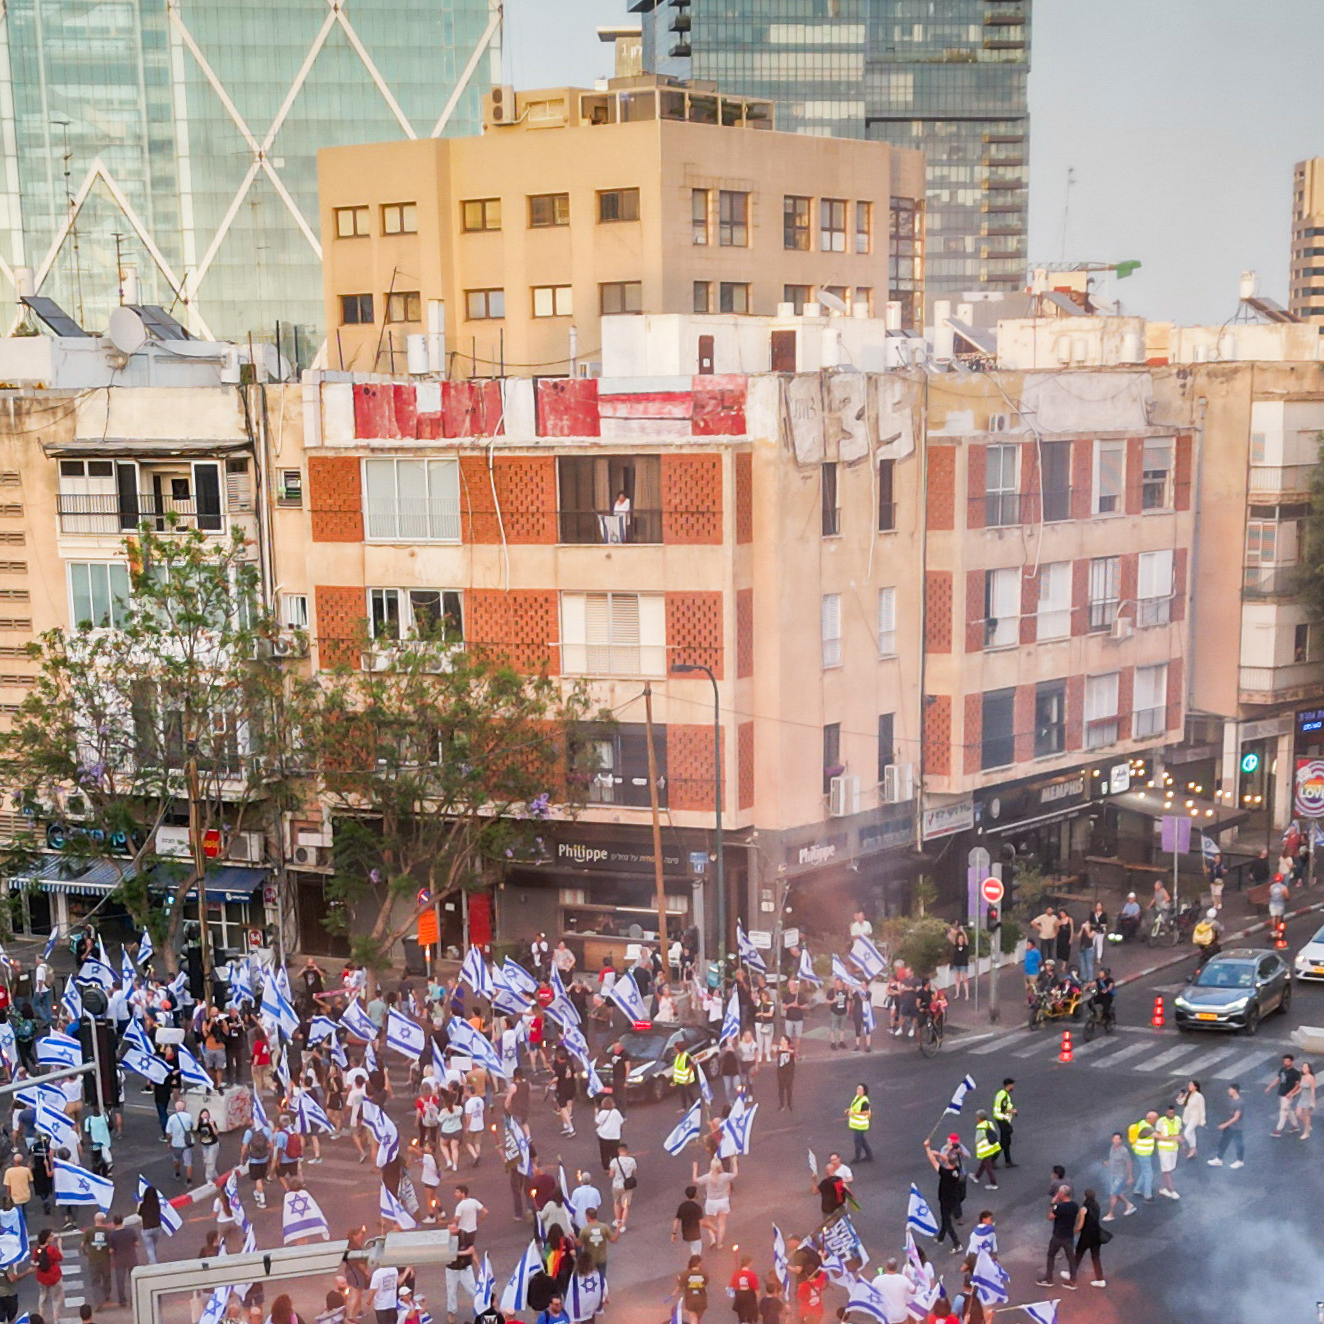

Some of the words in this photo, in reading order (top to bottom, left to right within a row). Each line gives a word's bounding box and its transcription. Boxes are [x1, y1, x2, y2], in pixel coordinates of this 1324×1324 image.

[1040, 780, 1084, 804] MEMPHIS
[558, 843, 608, 863] Philippe
[798, 844, 836, 866] Philippe
